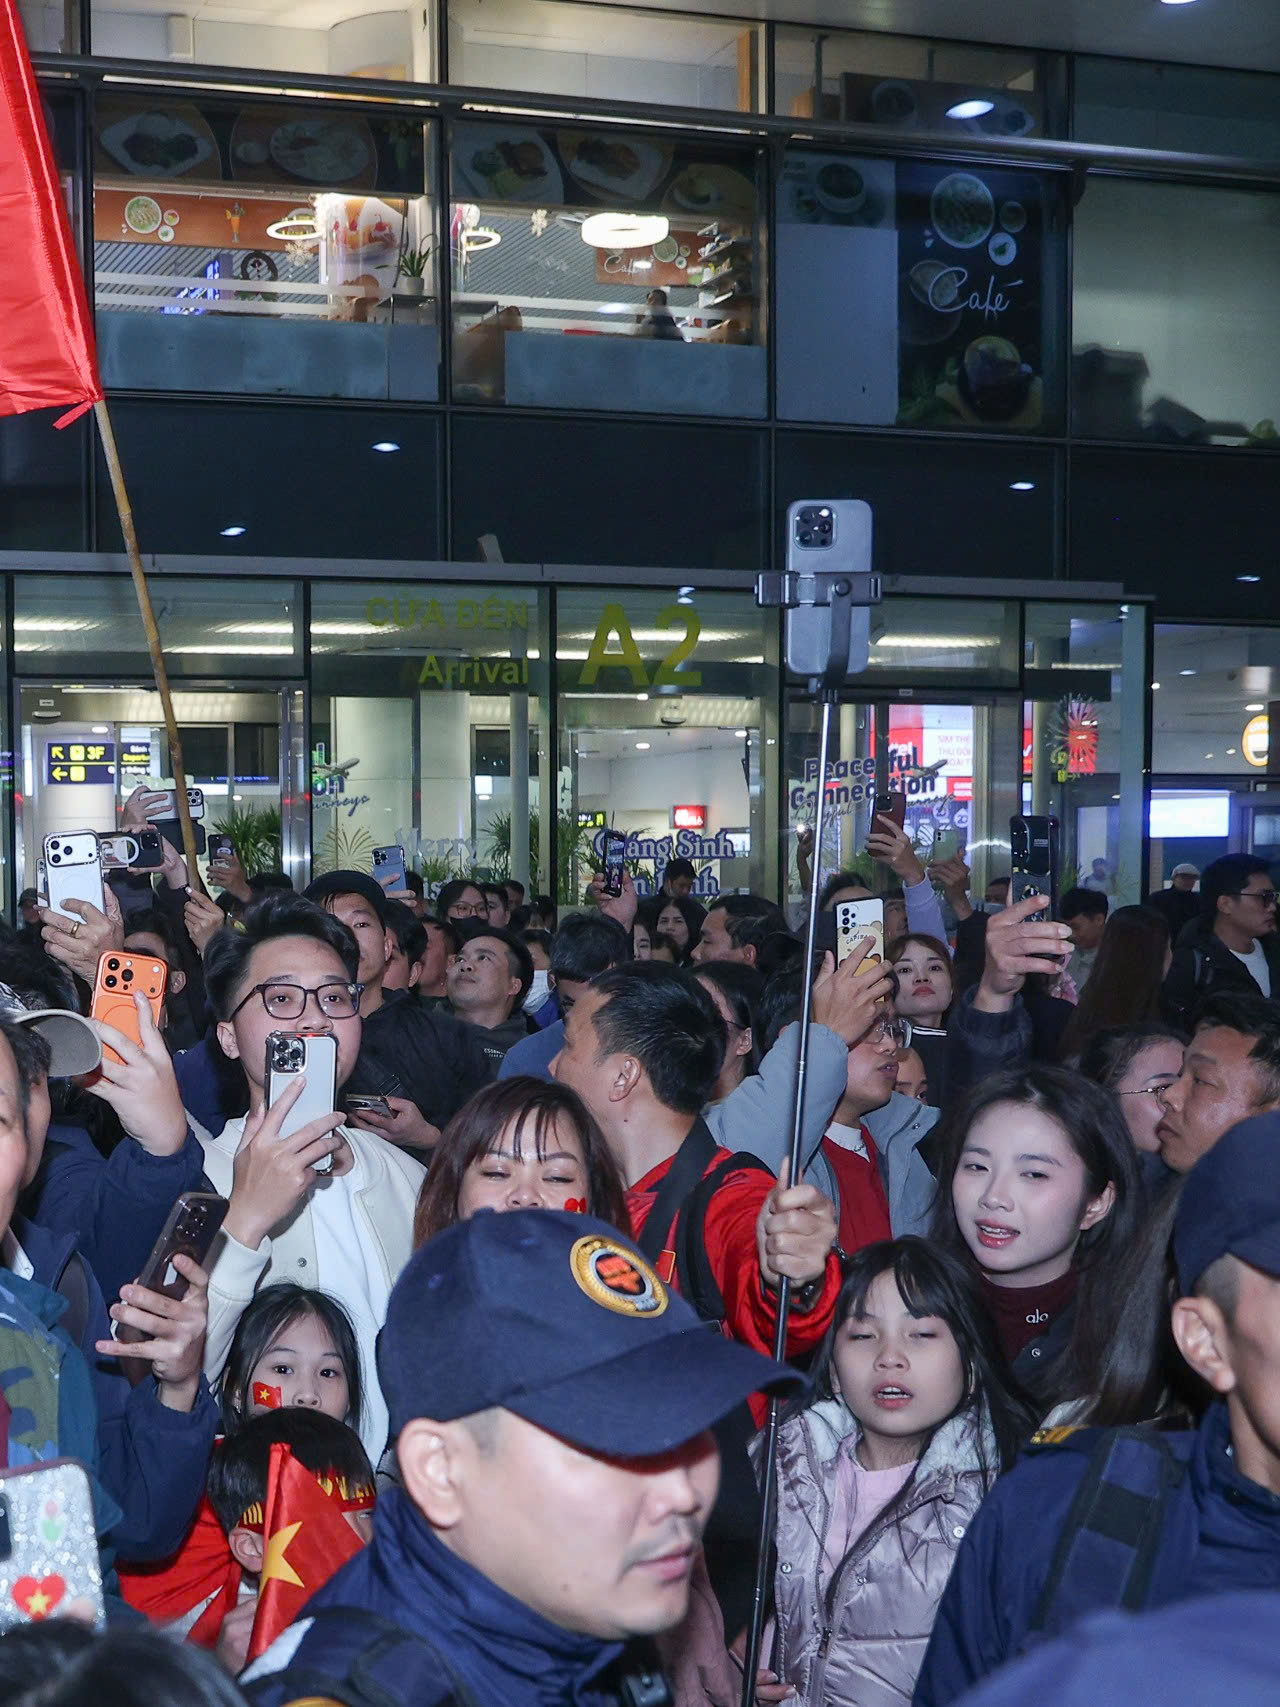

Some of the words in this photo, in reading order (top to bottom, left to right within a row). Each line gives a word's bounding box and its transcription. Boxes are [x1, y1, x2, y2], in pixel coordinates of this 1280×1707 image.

[928, 266, 1024, 320] Café
[577, 603, 702, 686] A2
[418, 652, 529, 684] Arrival
[677, 829, 736, 859] Sinh
